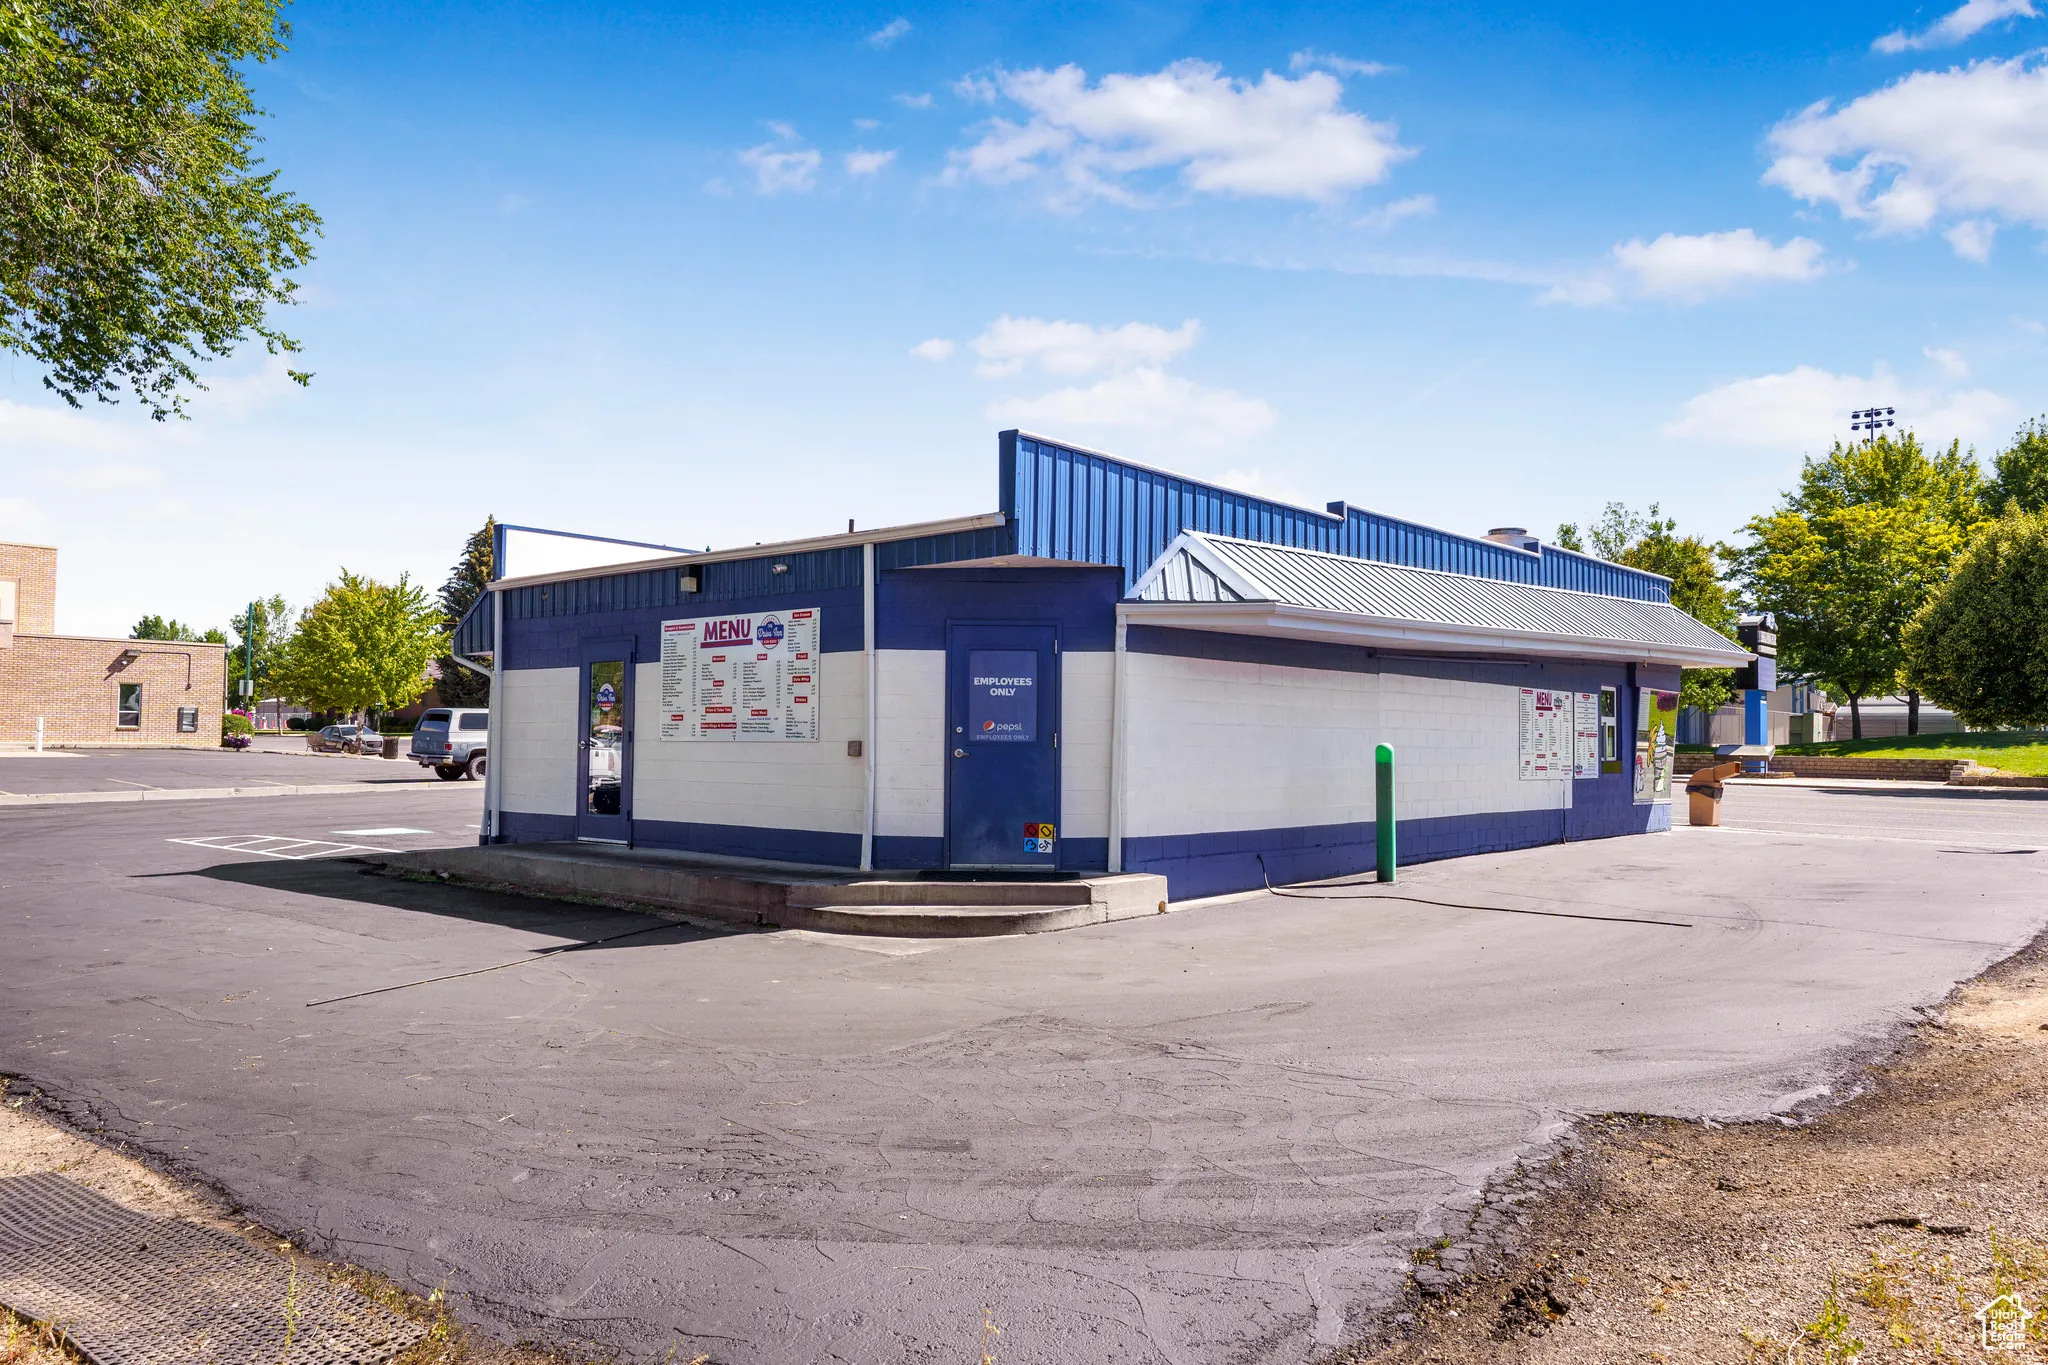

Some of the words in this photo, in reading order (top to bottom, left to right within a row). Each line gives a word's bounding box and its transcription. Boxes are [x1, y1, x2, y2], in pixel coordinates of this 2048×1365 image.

[704, 618, 751, 641] MENU
[974, 677, 1032, 686] EMPLOYEES
[990, 688, 1016, 696] ONLY
[1536, 692, 1552, 706] MENU
[996, 722, 1022, 732] pepsi
[1040, 826, 1052, 837] 0
[1026, 839, 1036, 851] 3
[1038, 840, 1052, 851] SA
